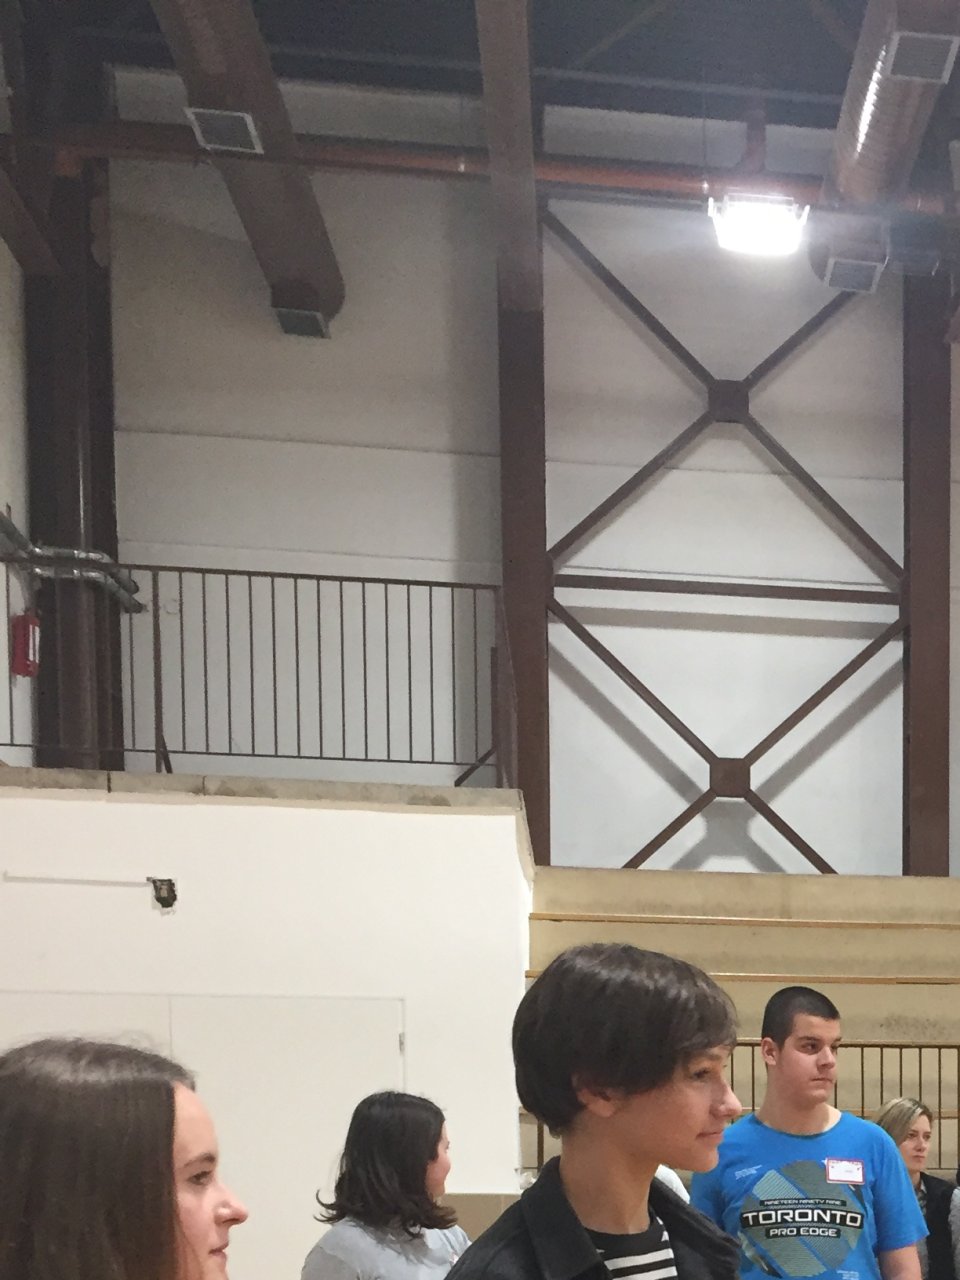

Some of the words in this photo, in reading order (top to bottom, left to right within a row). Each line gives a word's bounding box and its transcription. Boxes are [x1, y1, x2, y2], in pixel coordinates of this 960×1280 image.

[742, 1208, 862, 1227] TORONTO
[769, 1227, 797, 1237] PRO
[800, 1227, 838, 1237] EDGE
